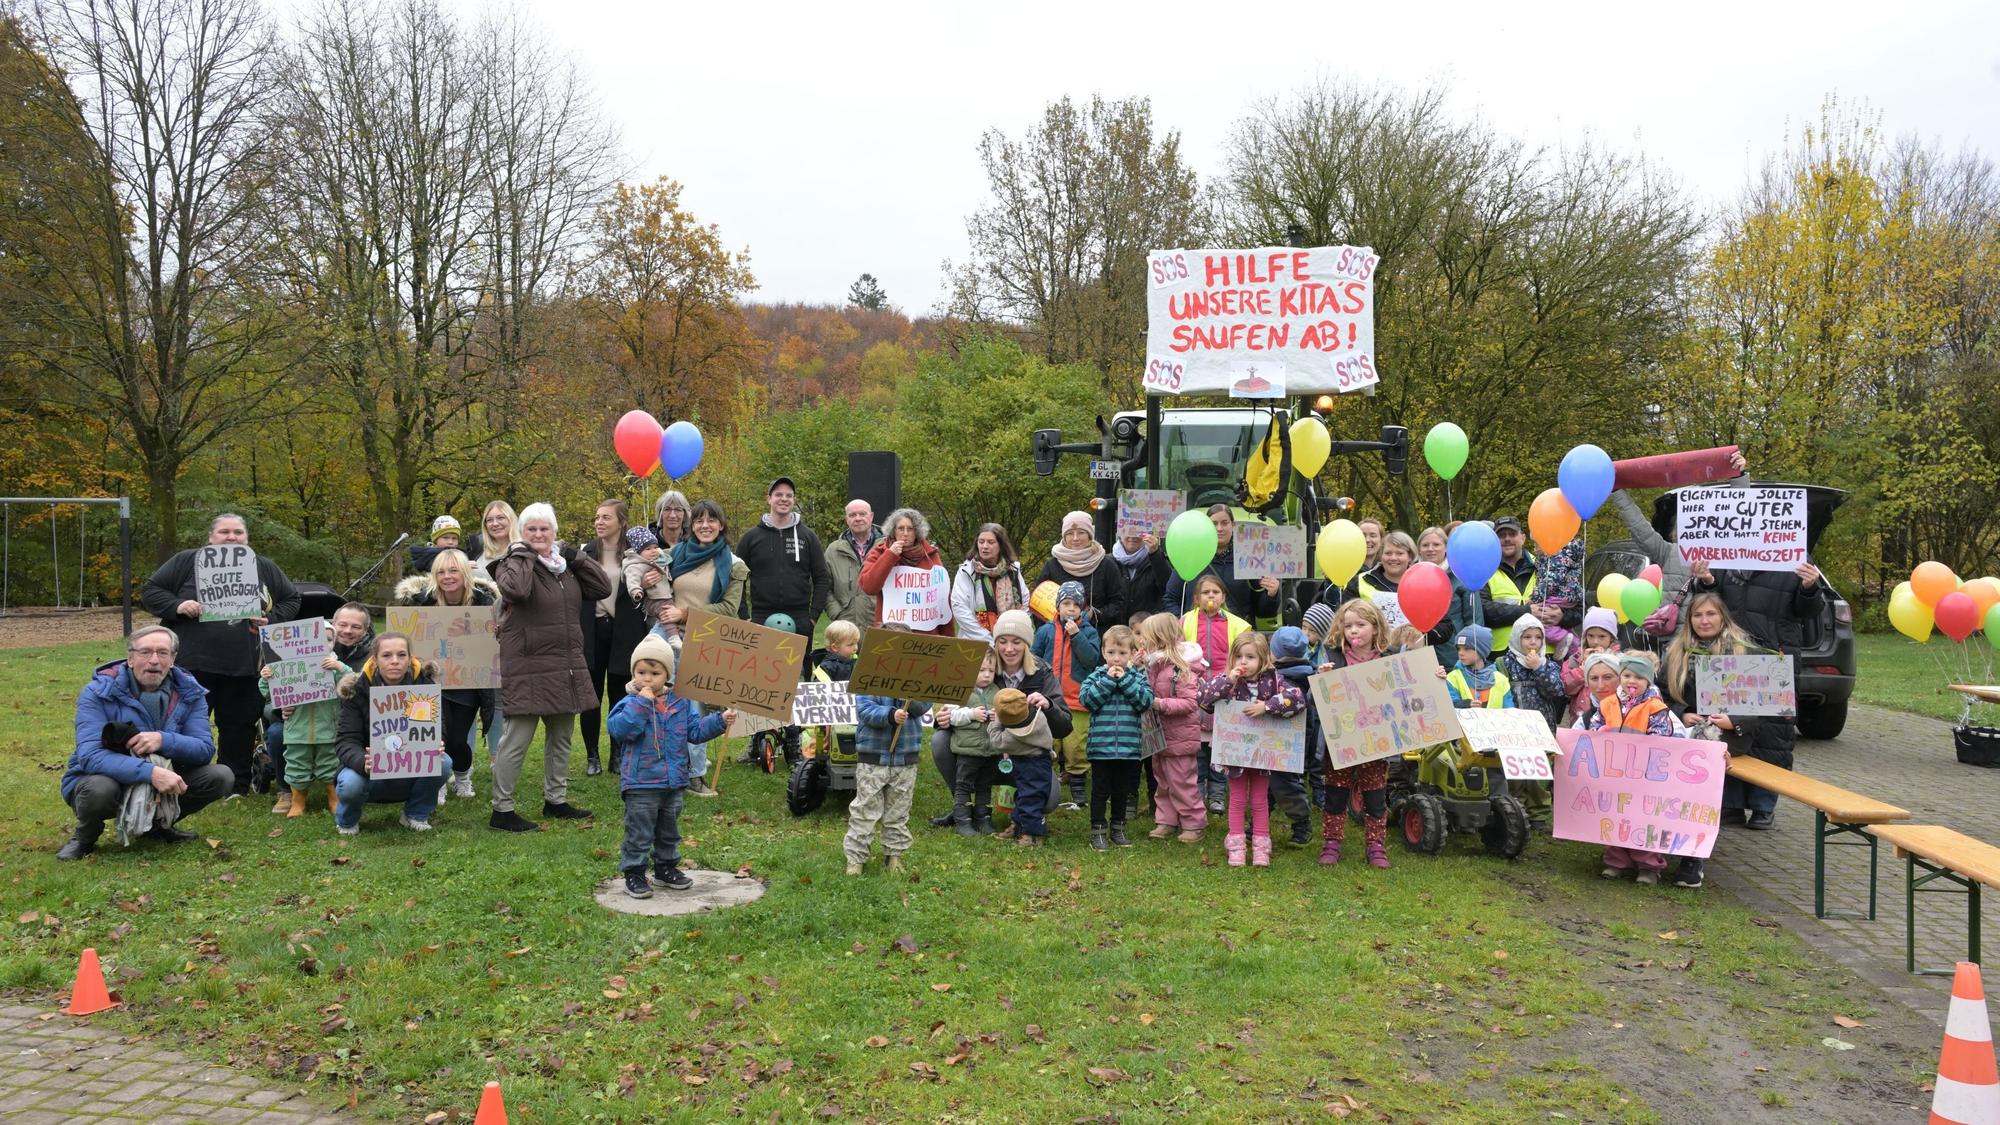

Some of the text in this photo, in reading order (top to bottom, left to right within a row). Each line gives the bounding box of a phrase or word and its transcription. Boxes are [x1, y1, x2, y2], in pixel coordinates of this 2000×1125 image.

[1152, 254, 1189, 284] SOS
[1205, 252, 1310, 287] HILFE
[1337, 248, 1375, 280] SOS
[1169, 289, 1272, 320] UNSERE
[1169, 322, 1289, 352] SAUFEN
[1147, 359, 1183, 389] SOS
[1336, 354, 1374, 387] SOS
[1680, 490, 1803, 502] EIGENTLICH SOLLTE
[1682, 502, 1794, 516] HIER EIN GUTER
[1685, 516, 1805, 530] SPRUCH STEHEN,
[1680, 530, 1709, 540] ABER
[1763, 532, 1796, 543] KEINE
[203, 547, 247, 568] R.I.P.
[1680, 545, 1805, 562] VORBEREITUNGSZEIT
[212, 572, 242, 584] GUTE
[895, 573, 930, 588] KINDER
[200, 583, 259, 602] PÄDAGOGIK
[906, 592, 920, 604] EIN
[888, 609, 907, 620] AUF
[720, 624, 760, 643] OHNE
[297, 645, 324, 655] MEHR
[902, 640, 950, 654] OHNE
[698, 643, 782, 683] KITA'S
[875, 655, 966, 681] KITA'S
[273, 686, 294, 695] AND
[686, 673, 733, 695] ALLES
[856, 675, 899, 690] GEHT
[900, 680, 922, 692] ES
[924, 684, 973, 699] NICHT
[274, 689, 327, 707] BURNOUT
[373, 691, 406, 714] WIR
[372, 717, 408, 737] SIND
[409, 726, 435, 741] AM
[373, 750, 440, 773] LIMIT
[1506, 755, 1549, 777] SOS
[1568, 734, 1709, 784] ALLES
[1571, 786, 1720, 827] AUF UNSEREN
